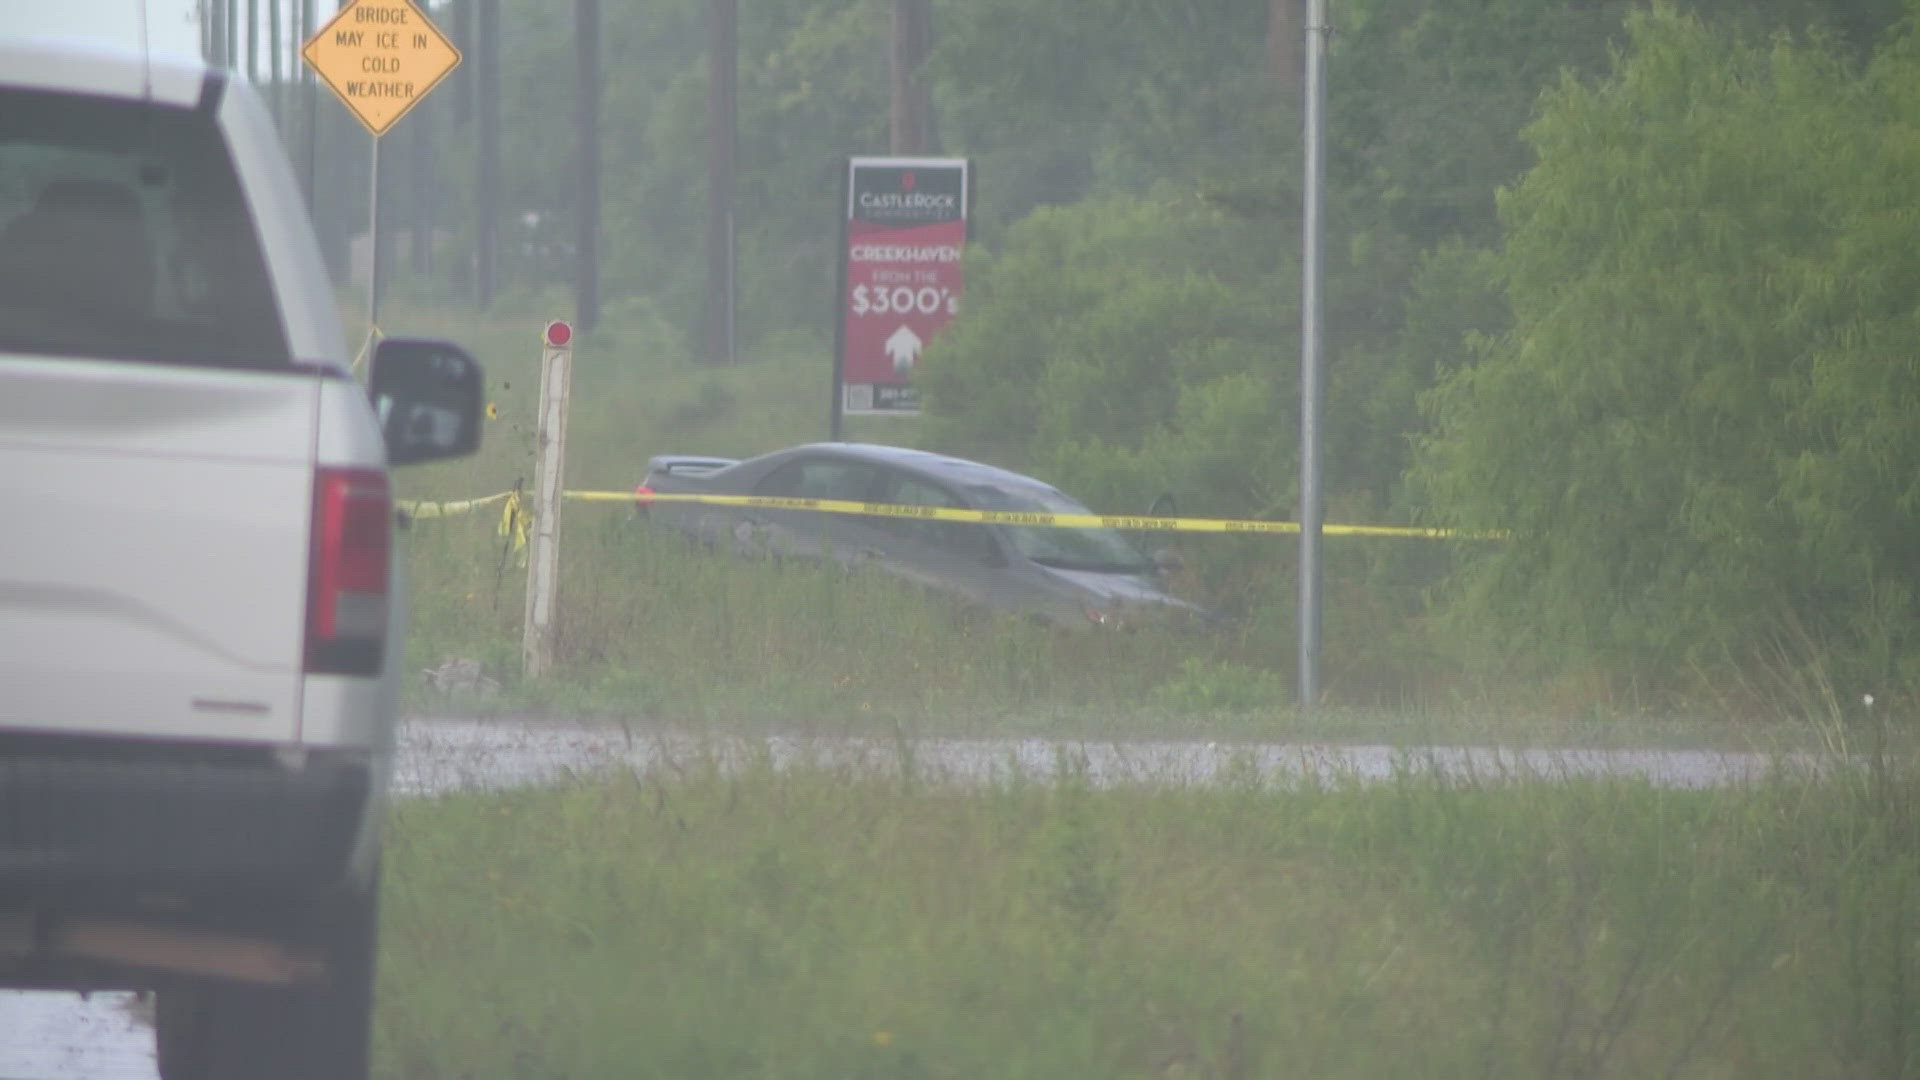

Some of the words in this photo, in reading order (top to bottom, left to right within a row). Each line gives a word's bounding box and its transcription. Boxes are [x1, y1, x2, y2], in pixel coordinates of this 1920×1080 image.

[355, 7, 409, 24] BRIDGE
[336, 31, 364, 46] MAY
[377, 33, 399, 48] ICE
[413, 34, 427, 49] IN
[362, 56, 400, 73] COLD
[347, 81, 414, 98] WEATHER
[851, 245, 961, 262] CREEKHAVEN
